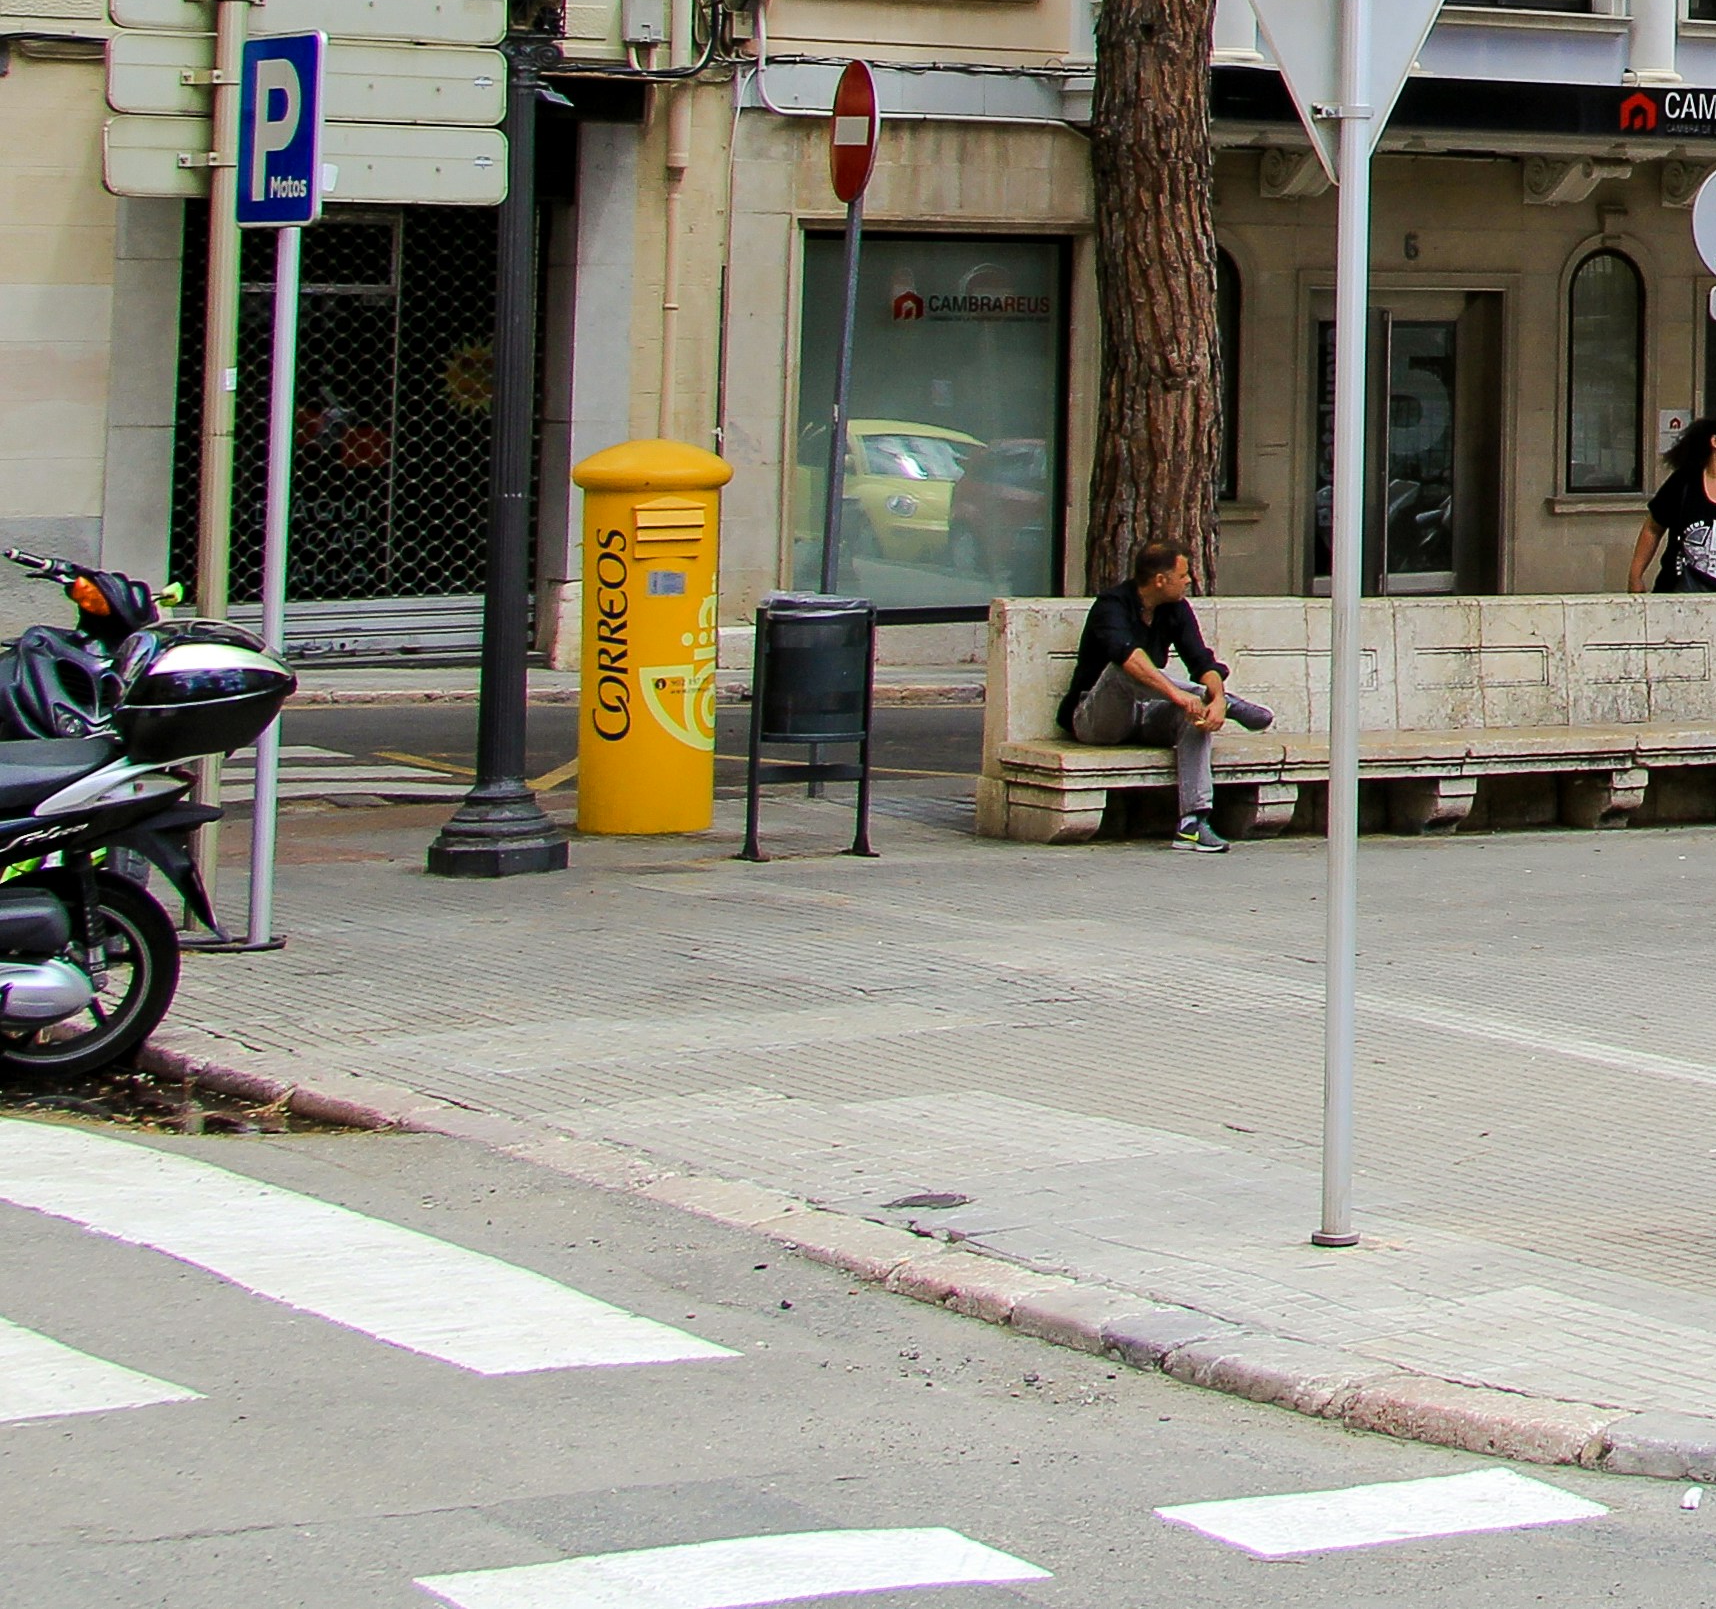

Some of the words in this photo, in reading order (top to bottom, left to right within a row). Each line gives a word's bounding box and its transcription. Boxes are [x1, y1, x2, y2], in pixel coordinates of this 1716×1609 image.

[252, 59, 301, 202] P
[270, 175, 307, 199] Motos
[929, 295, 1049, 313] CAMBRAREUS
[592, 528, 630, 741] CORREOS
